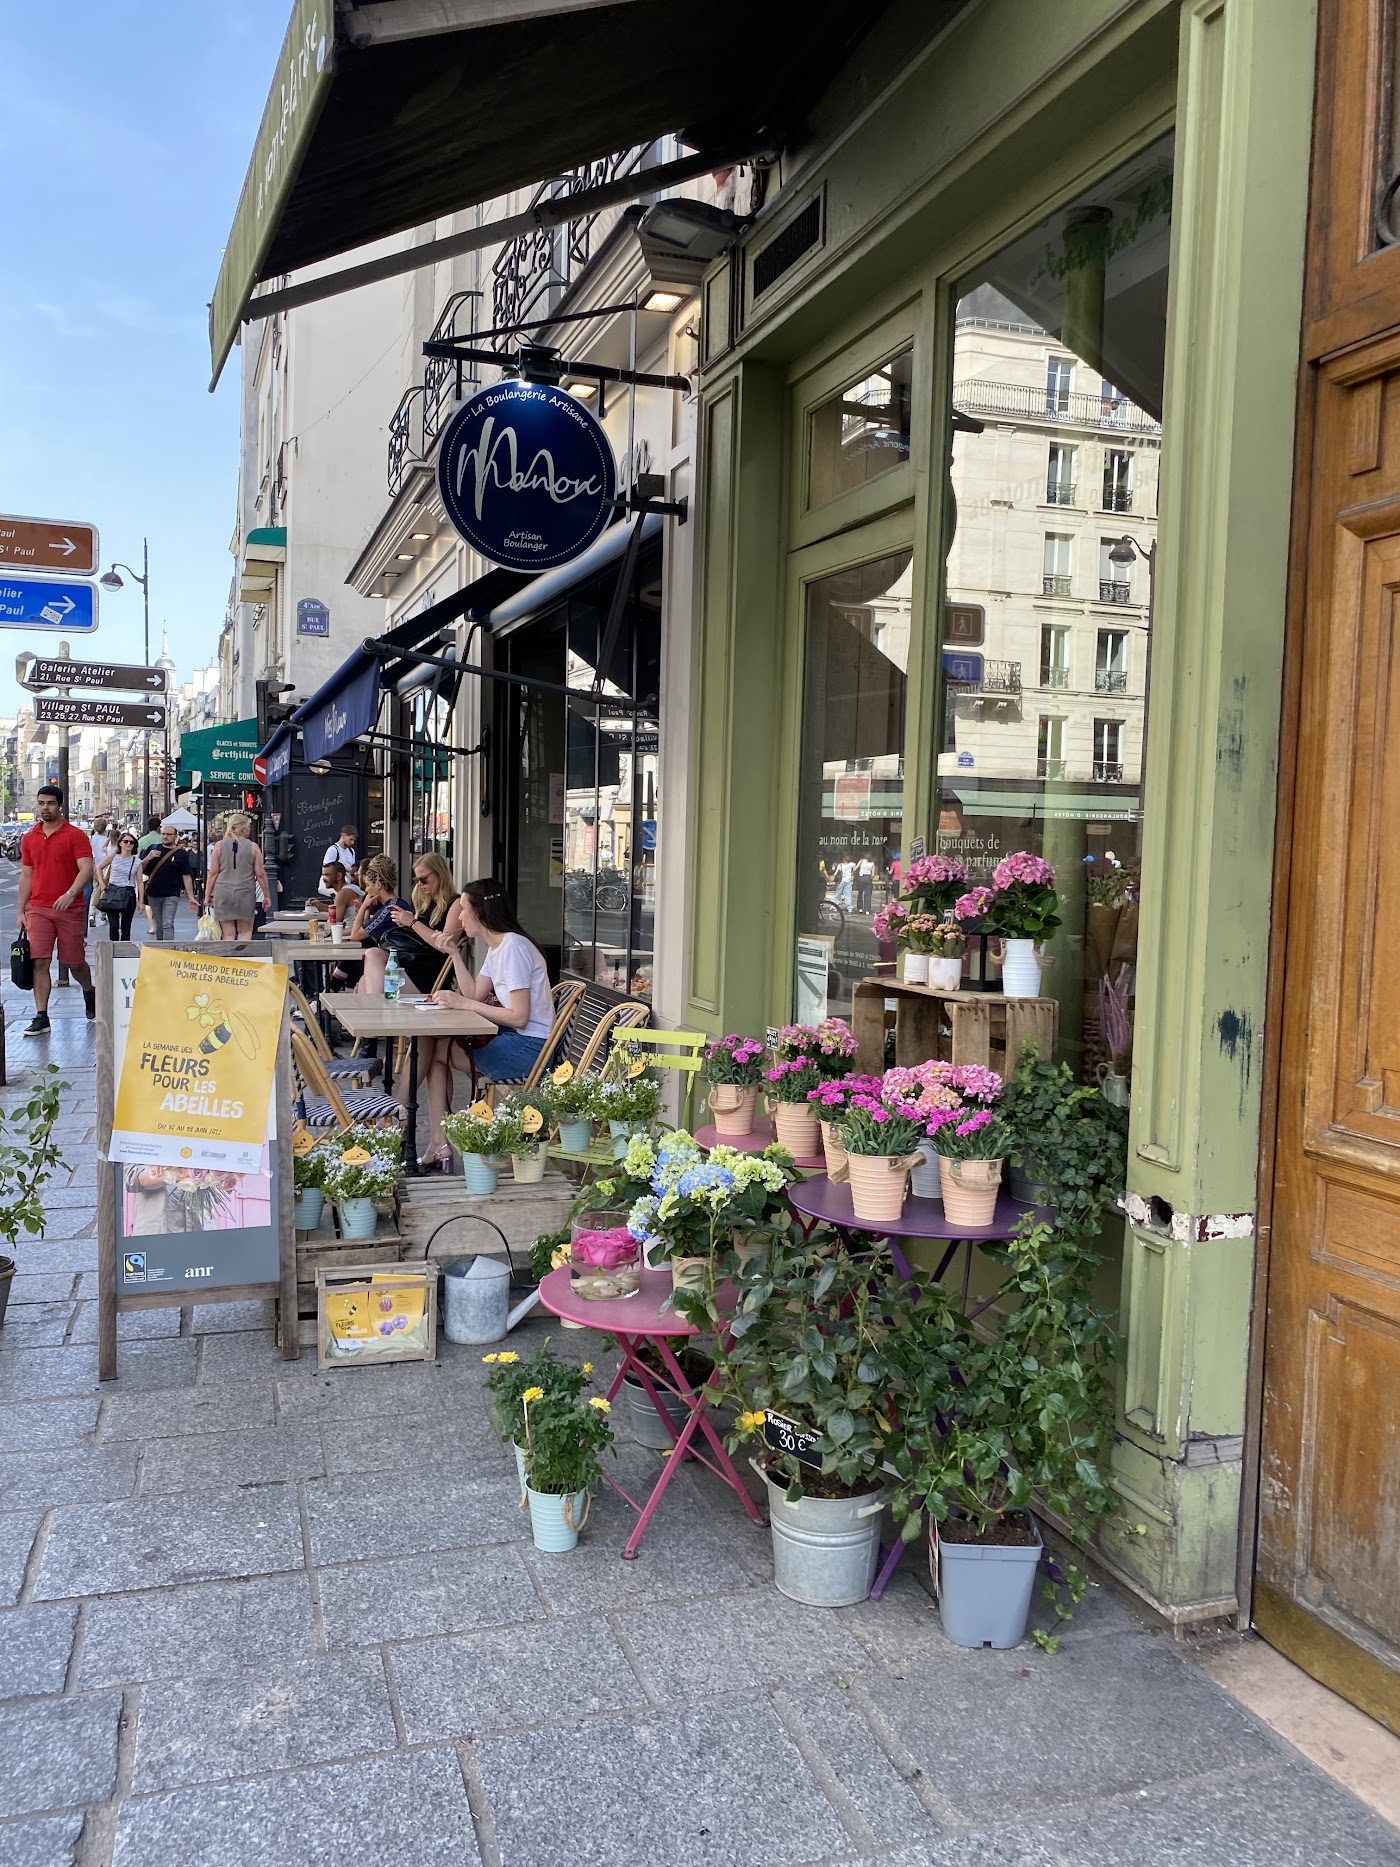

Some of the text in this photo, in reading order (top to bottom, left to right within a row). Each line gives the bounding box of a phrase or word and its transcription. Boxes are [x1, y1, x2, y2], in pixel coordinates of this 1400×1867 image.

[471, 389, 589, 429] La Boulangerie Artisane
[0, 529, 16, 538] aul
[509, 530, 542, 542] Artisan
[14, 546, 35, 556] Paul
[503, 538, 549, 552] Boulanger
[0, 587, 23, 599] lier
[0, 604, 24, 615] Paul
[40, 663, 115, 676] Galerie Atelier
[40, 673, 104, 685] 21, Rue St Paul
[41, 701, 122, 714] Village St PAUL
[81, 714, 95, 722] Rue
[96, 714, 104, 722] St
[106, 715, 124, 723] Paul
[210, 771, 257, 781] SERVICE CONT
[297, 794, 344, 815] Breakfast
[304, 815, 334, 832] Lunch
[819, 831, 888, 846] au nom de la rose
[940, 834, 984, 853] bouquets
[987, 833, 1000, 850] de
[170, 960, 259, 978] UN MILLIARD DE FLEURS
[177, 969, 197, 980] POUR
[199, 973, 213, 982] LES
[153, 1043, 180, 1052] SEMAINE
[180, 1046, 193, 1054] DES
[140, 1052, 210, 1078] FLEURS
[152, 1074, 217, 1094] POUR LES
[158, 1122, 167, 1130] DU
[184, 1266, 214, 1278] anr
[779, 1430, 806, 1451] 30 €
